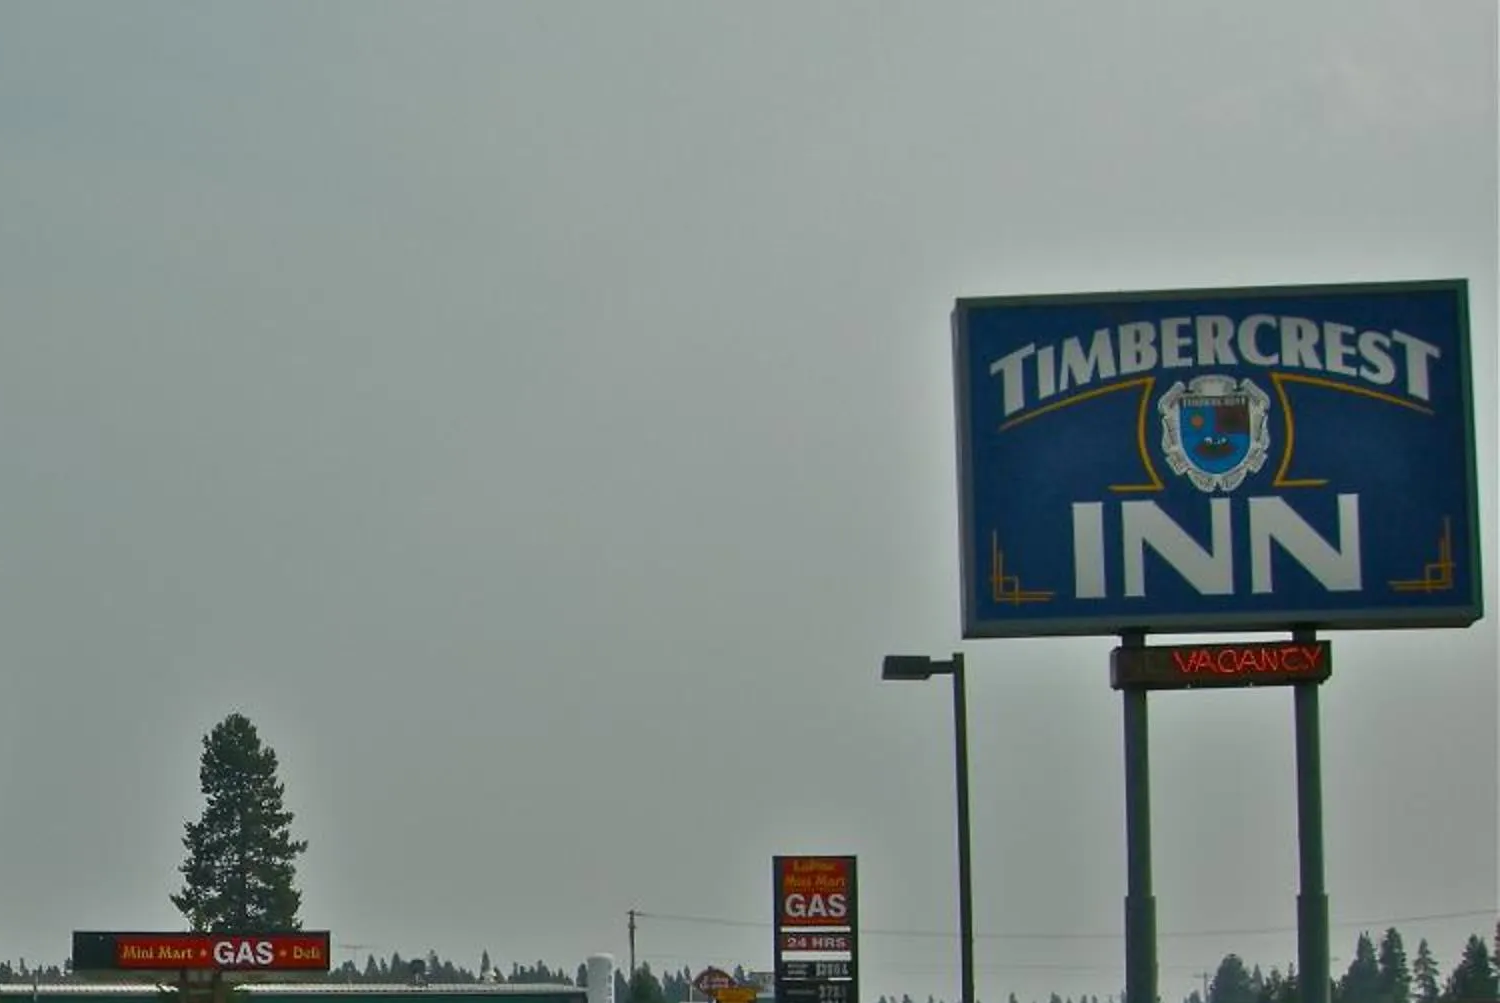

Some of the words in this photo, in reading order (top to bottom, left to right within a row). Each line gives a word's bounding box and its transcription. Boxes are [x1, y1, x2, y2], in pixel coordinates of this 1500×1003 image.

[990, 315, 1440, 417] TIMBERCREST
[1072, 493, 1363, 599] INN
[1172, 646, 1322, 674] VACANCY
[785, 893, 847, 918] GAS
[122, 945, 153, 959] Mini
[158, 945, 194, 959] Mart
[213, 941, 274, 965] GAS
[293, 945, 321, 959] Deli
[787, 937, 807, 948] 24
[812, 937, 847, 948] HRS
